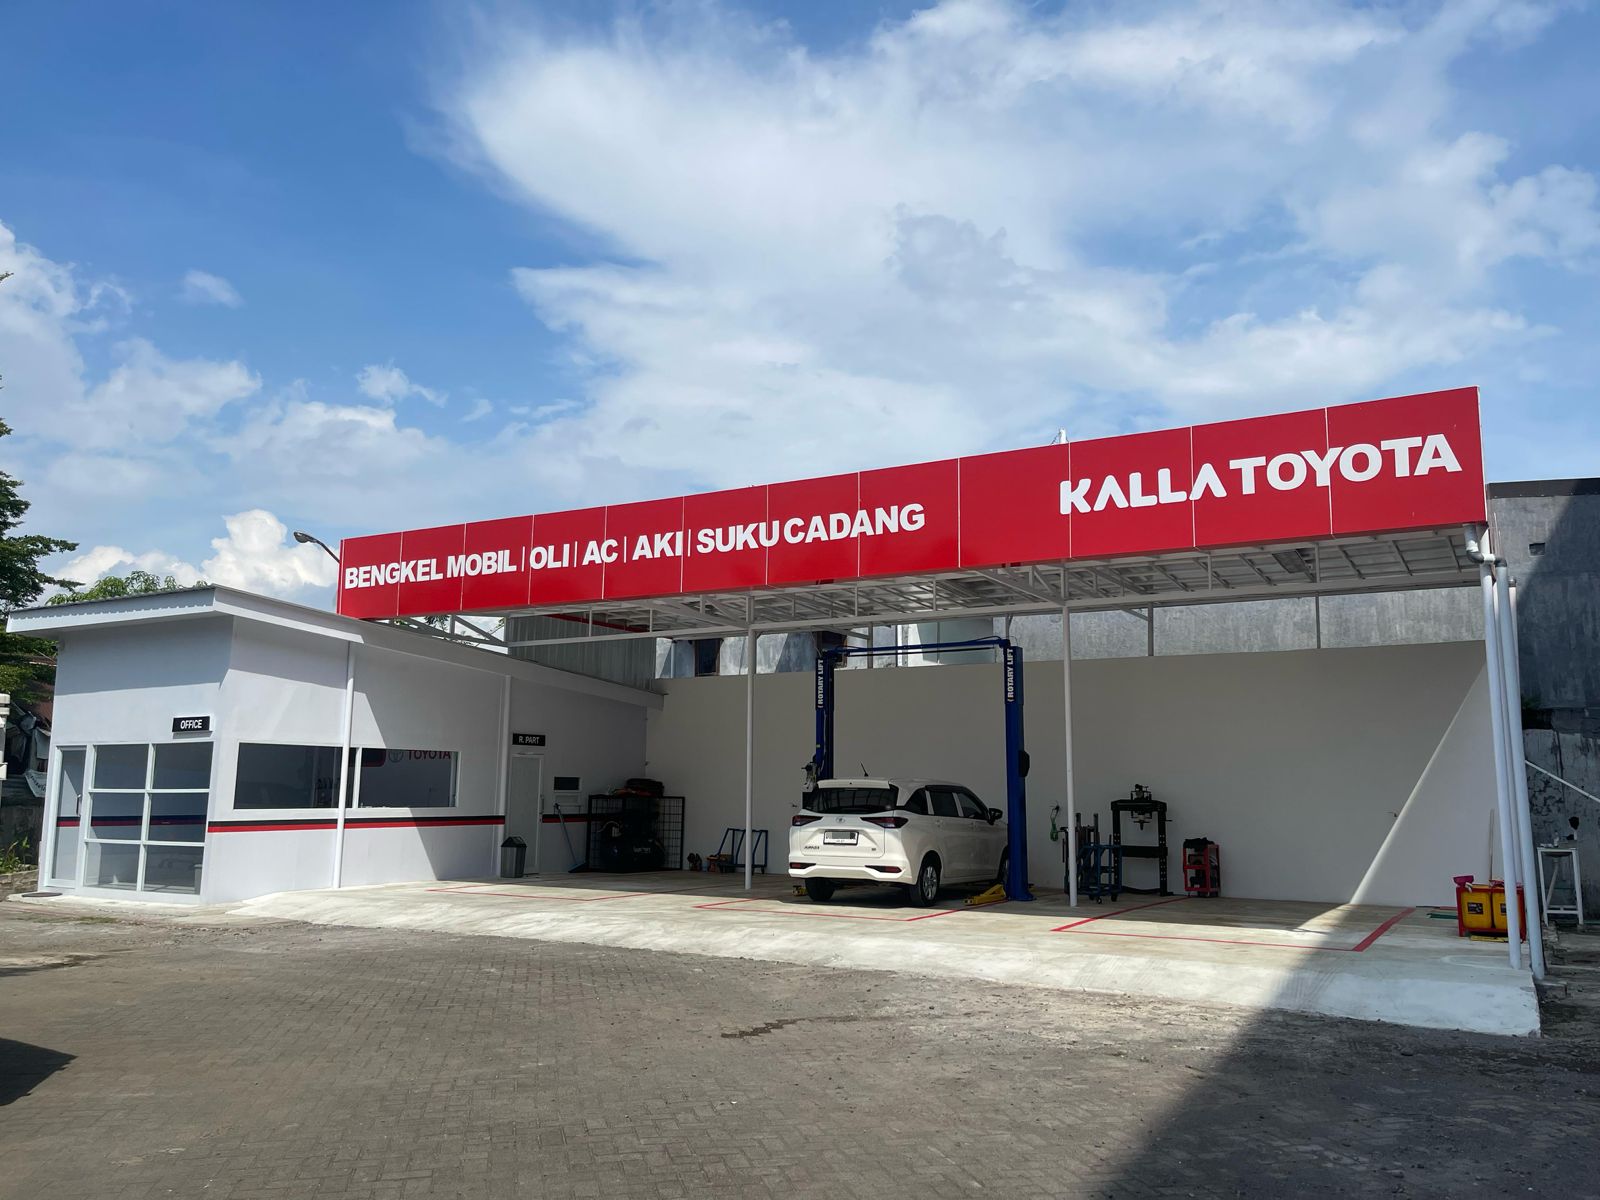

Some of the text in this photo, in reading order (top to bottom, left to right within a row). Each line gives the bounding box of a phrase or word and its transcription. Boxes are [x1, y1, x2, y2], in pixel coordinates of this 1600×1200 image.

[1059, 433, 1463, 515] KALLA TOYOTA
[344, 503, 926, 590] BENGKEL MOBIL OLI AC AKI SUKU CADANG
[180, 719, 203, 729] OFFICE
[525, 736, 540, 744] PART
[407, 750, 451, 760] TOYOTA
